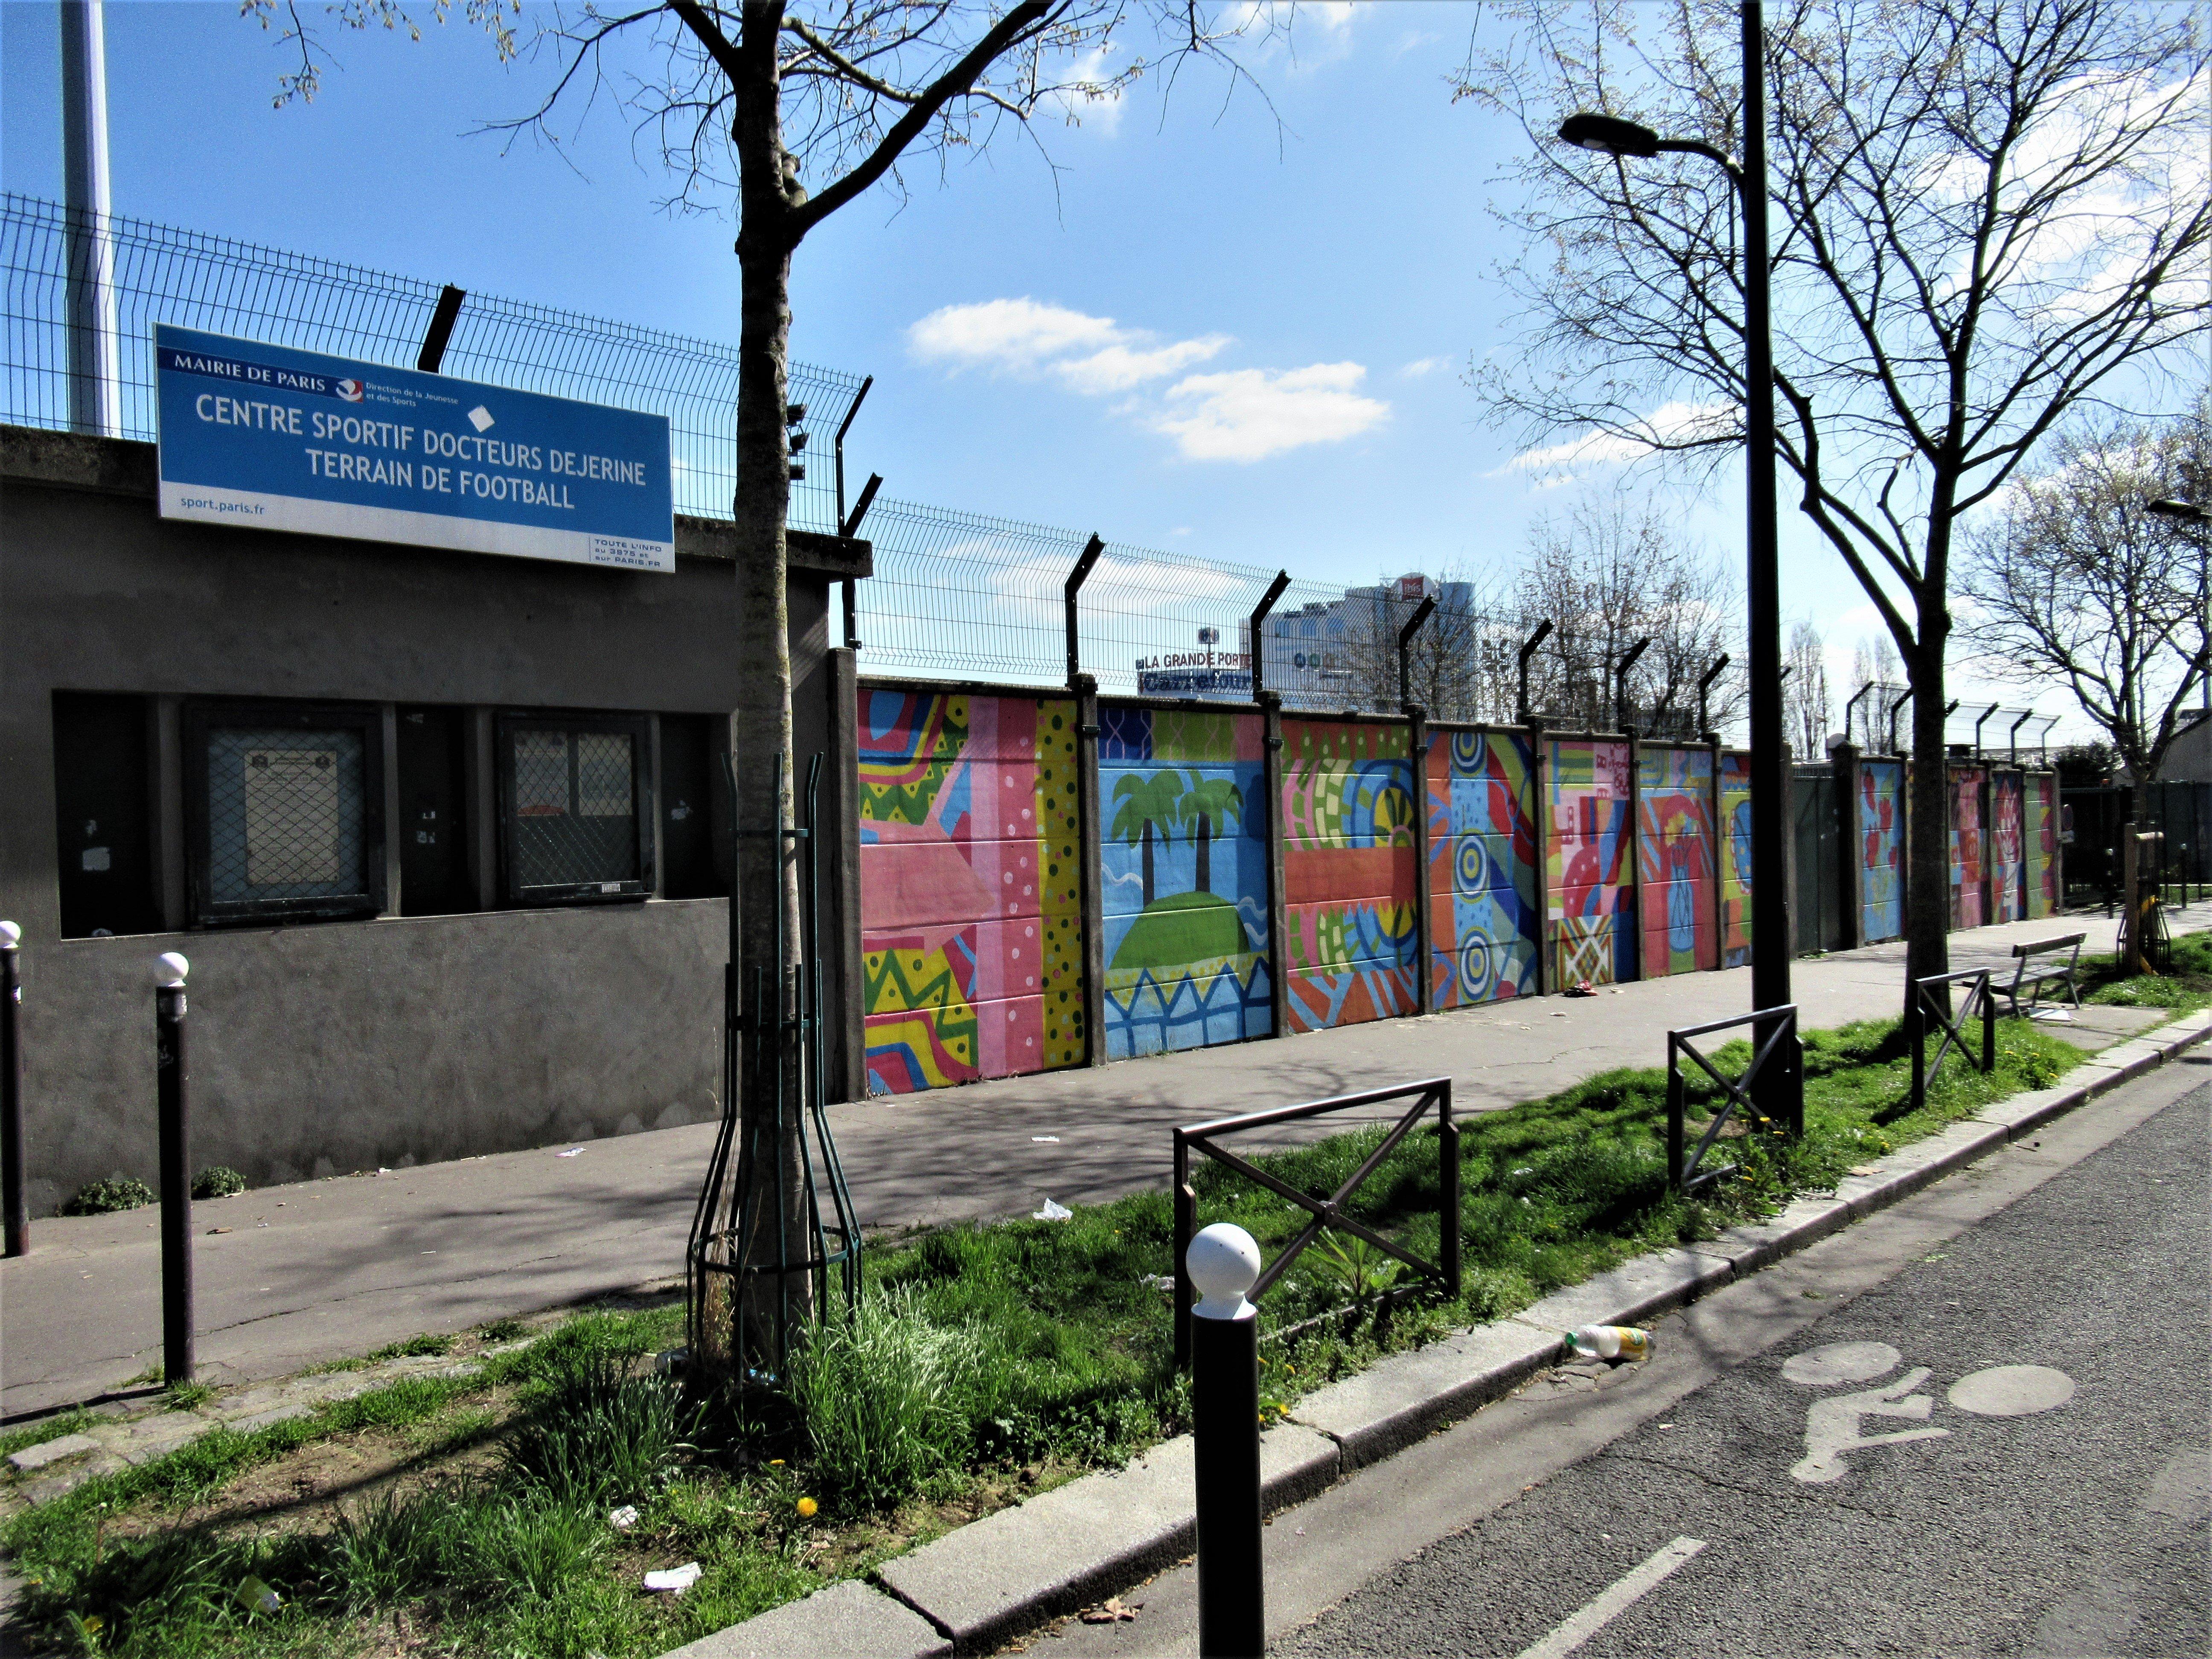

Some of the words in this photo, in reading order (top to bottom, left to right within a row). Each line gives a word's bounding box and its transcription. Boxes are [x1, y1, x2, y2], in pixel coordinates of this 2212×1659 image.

[175, 354, 241, 378] MAIRIE
[247, 367, 271, 381] DE
[278, 372, 326, 392] PARIS
[366, 382, 402, 395] Direction
[404, 388, 413, 397] de
[425, 393, 459, 405] Jeunesse
[377, 394, 390, 402] des
[393, 396, 416, 407] Sports
[196, 393, 303, 435] CENTRE
[312, 411, 414, 450] SPORTIF
[424, 429, 542, 471] DOCTEURS
[550, 449, 646, 486] DEJERINE
[305, 448, 413, 489] TERRAIN
[422, 465, 452, 493] DE
[460, 471, 576, 509] FOOTBALL
[181, 496, 265, 515] sport.paris.fr
[595, 539, 627, 548] TOUTE
[632, 543, 662, 552] L'INFO
[609, 548, 636, 556] 3975
[615, 557, 661, 567] PARIS.FR
[1145, 655, 1160, 669] LA
[1164, 652, 1215, 667] GRANDE
